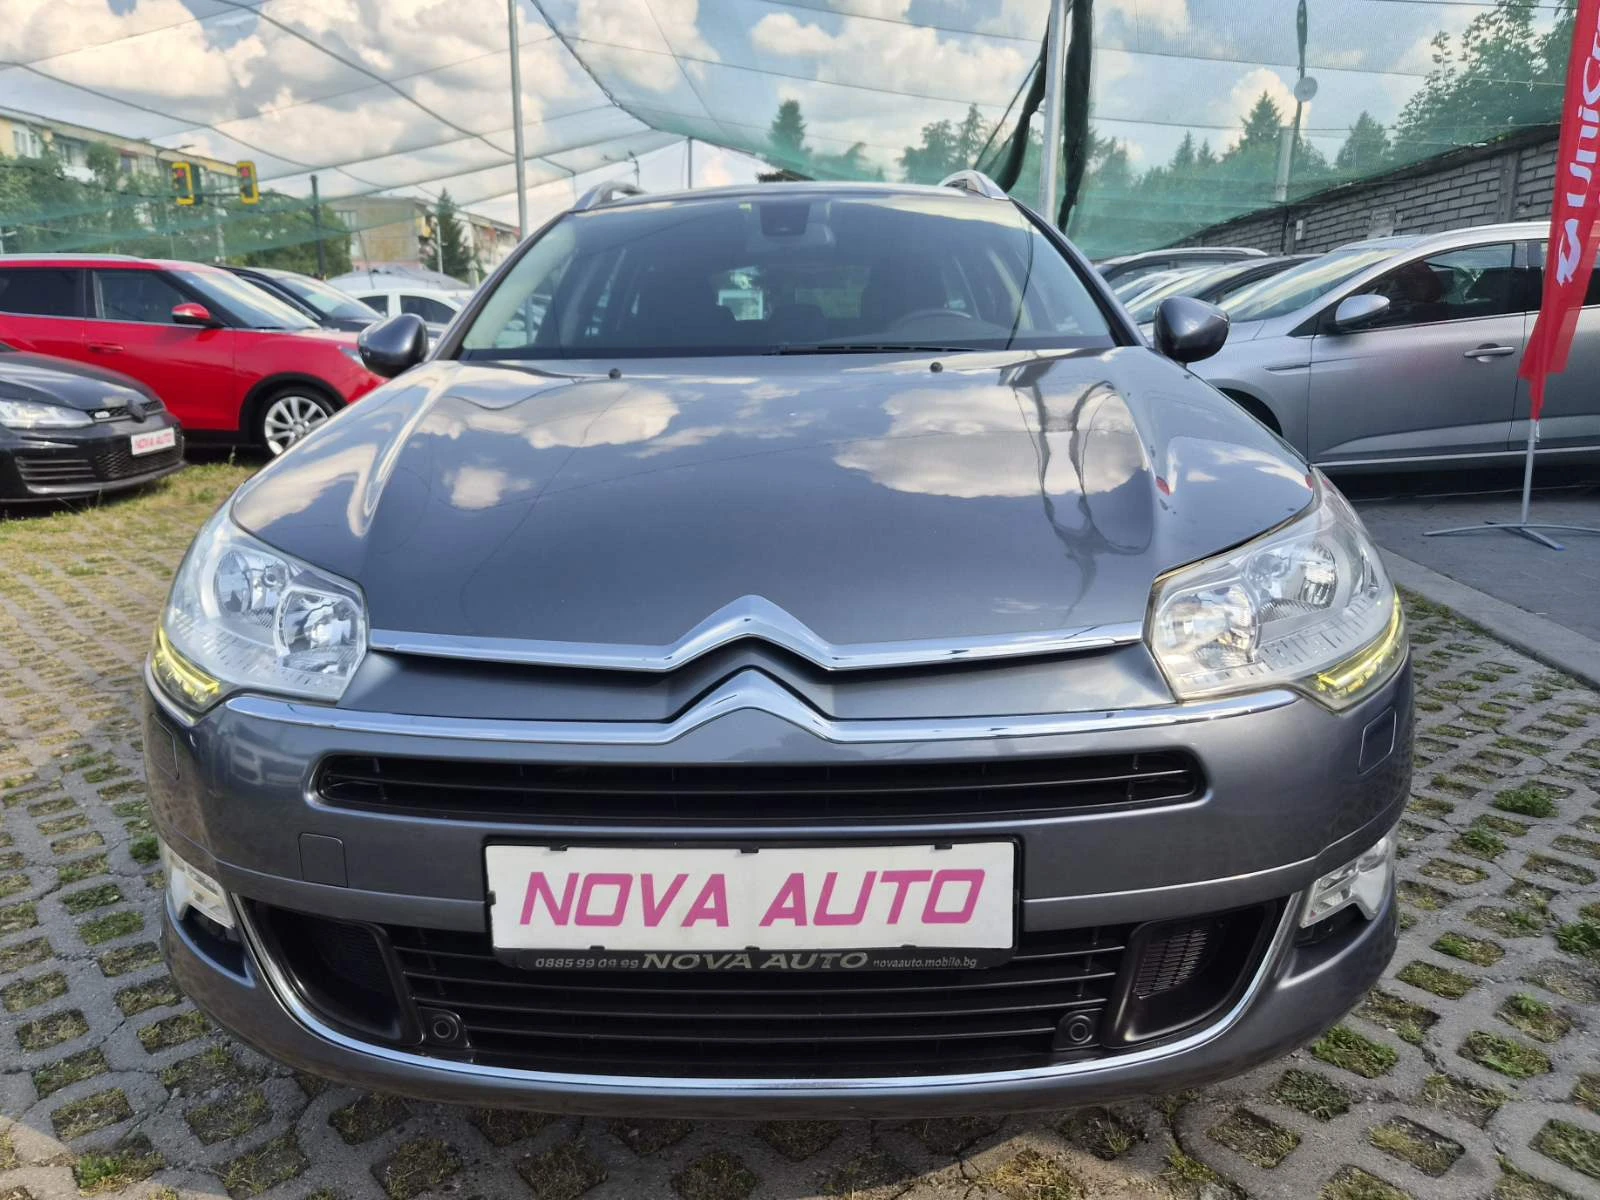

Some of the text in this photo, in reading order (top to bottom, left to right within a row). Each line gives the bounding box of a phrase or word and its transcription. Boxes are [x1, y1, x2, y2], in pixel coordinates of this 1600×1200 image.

[1567, 7, 1600, 207] UniC
[519, 869, 986, 927] NOVA AUTO
[642, 953, 753, 970] NOVA
[759, 952, 869, 970] AUTO
